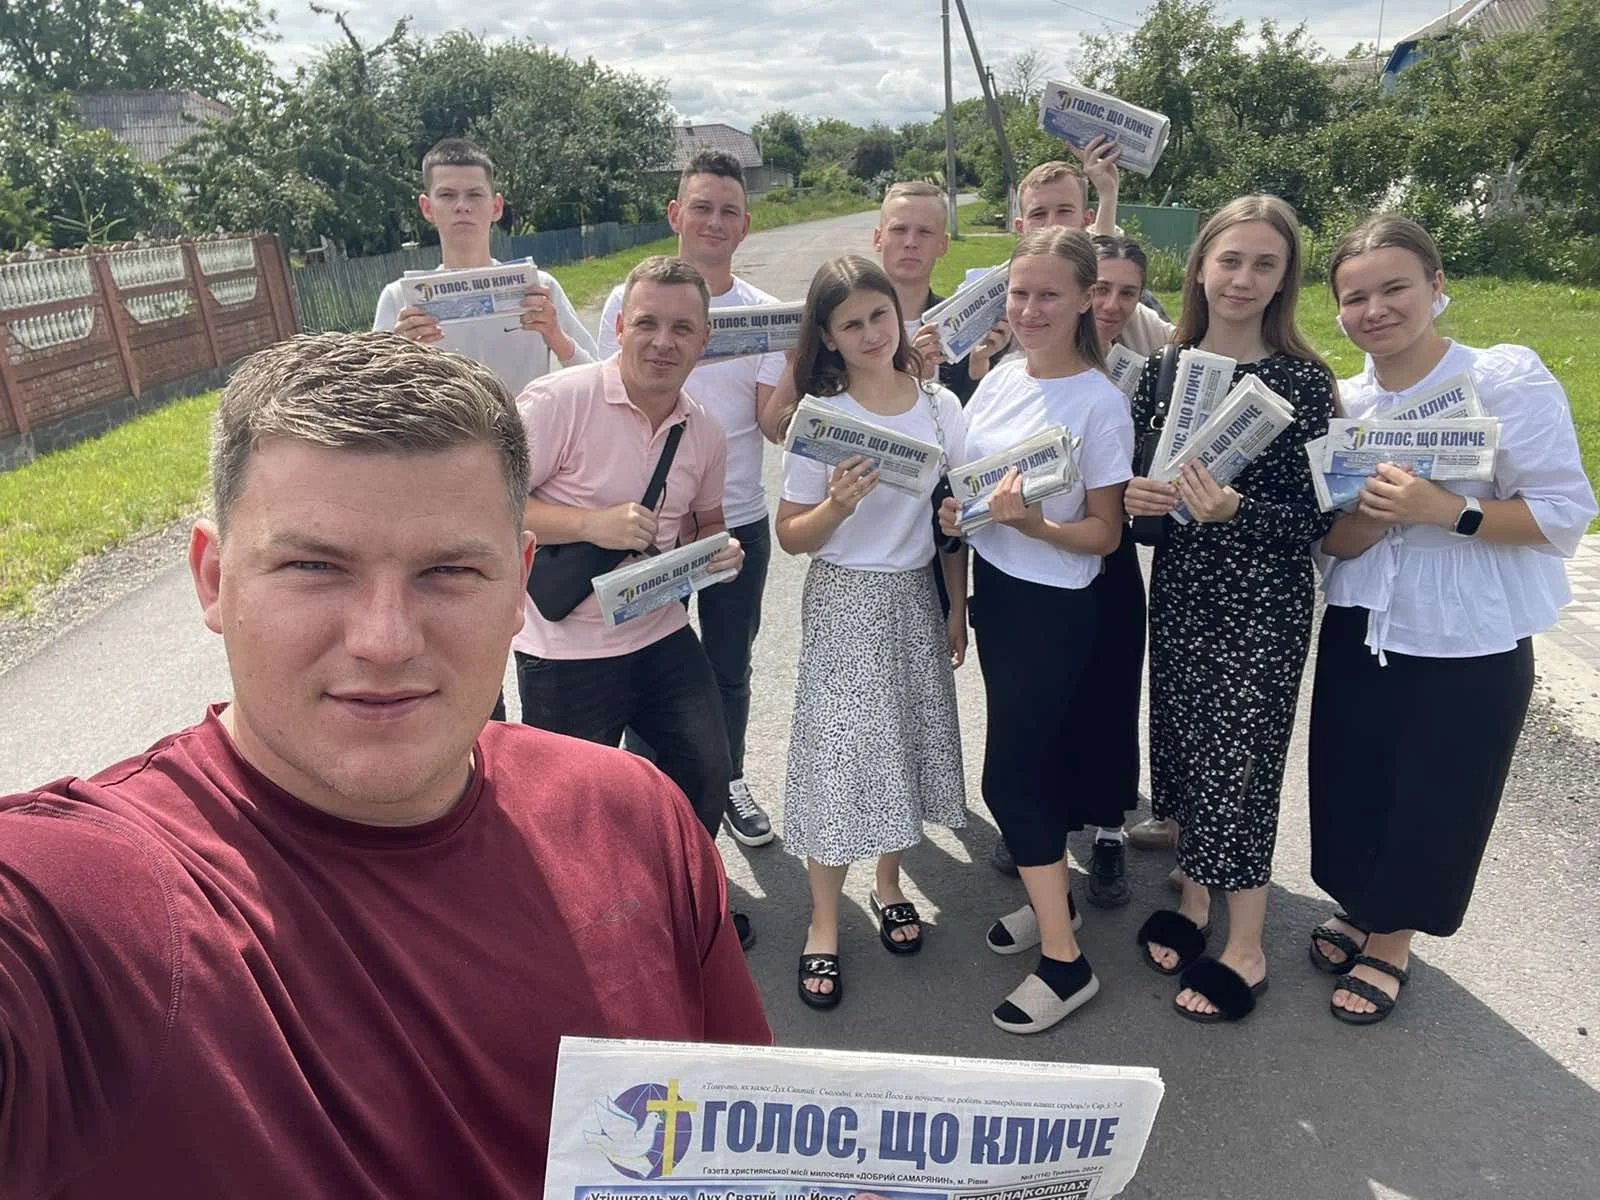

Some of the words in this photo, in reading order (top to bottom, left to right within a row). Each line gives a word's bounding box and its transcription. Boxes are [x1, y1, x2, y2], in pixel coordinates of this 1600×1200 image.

[1071, 97, 1105, 120] ГОЛОС,
[1106, 109, 1125, 125] ЩО
[1124, 116, 1154, 139] КЛИЧЕ
[434, 282, 472, 296] ГОЛОС,
[473, 279, 491, 292] ЩО
[493, 273, 527, 287] КЛИЧЕ
[713, 317, 749, 329] ГОЛОС,
[751, 315, 769, 327] ЩО
[1184, 363, 1205, 405] КЛИЧЕ
[1178, 407, 1194, 429] ЩО
[1418, 388, 1465, 419] КЛИЧЕ
[826, 427, 866, 448] ГОЛОС,
[868, 436, 889, 452] ЩО
[890, 444, 929, 463] КЛИЧЕ
[1210, 434, 1232, 455] ЩО
[1226, 404, 1262, 439] КЛИЧЕ
[1368, 431, 1414, 447] ГОЛОС,
[1417, 432, 1438, 448] ЩО
[1441, 432, 1485, 447] КЛИЧЕ
[1028, 446, 1059, 469] КЛИЧЕ
[636, 572, 671, 595] ГОЛОС,
[673, 563, 689, 577] ЩО
[701, 1100, 867, 1165] ГОЛОС,
[878, 1110, 961, 1171] ЩО
[970, 1116, 1120, 1166] КЛИЧЕ
[702, 1166, 729, 1175] Газета
[731, 1167, 789, 1176] християнської
[790, 1168, 808, 1176] місії
[809, 1171, 854, 1180] милосердя
[856, 1172, 896, 1181] «ДОБРИЙ
[896, 1175, 956, 1185] САМАРЯНИН»,
